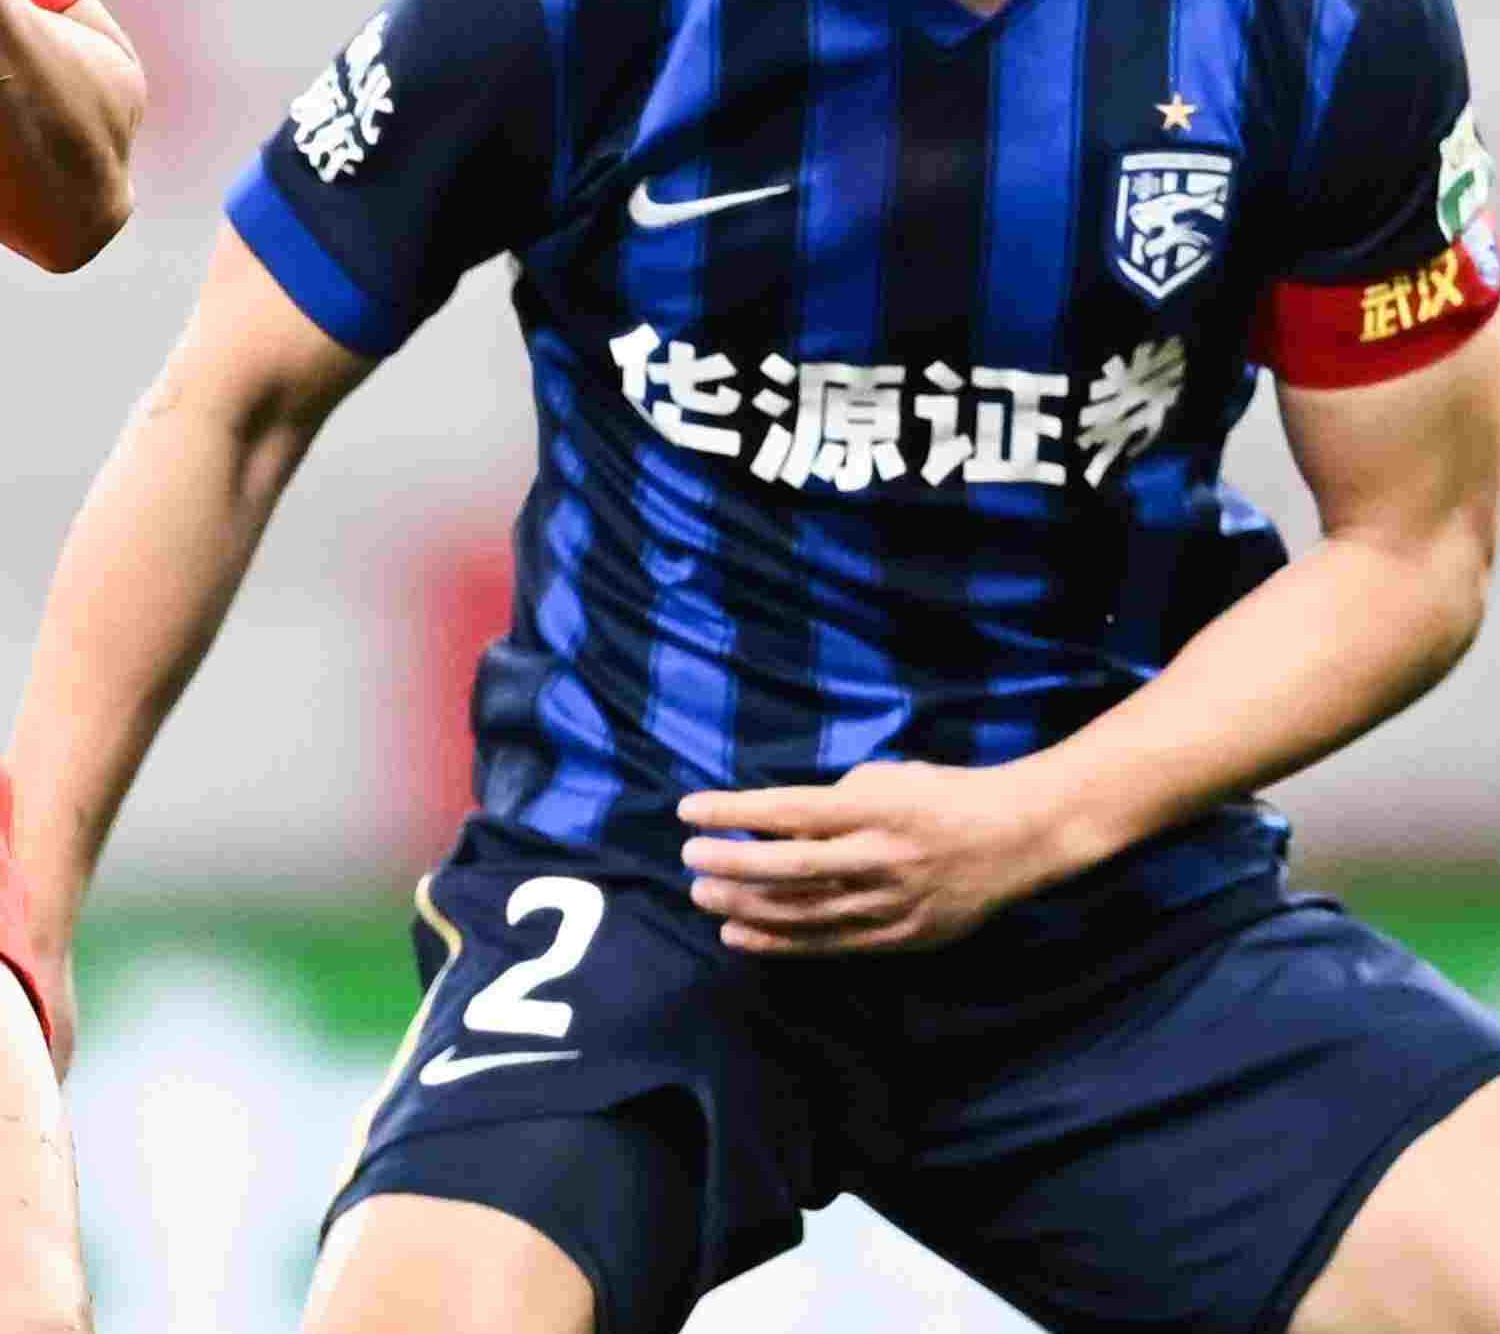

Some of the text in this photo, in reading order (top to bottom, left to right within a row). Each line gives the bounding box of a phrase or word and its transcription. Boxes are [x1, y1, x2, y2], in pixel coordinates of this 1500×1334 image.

[1358, 247, 1465, 343] 武汉
[609, 323, 1188, 491] 华源证券
[463, 875, 605, 1038] 2
